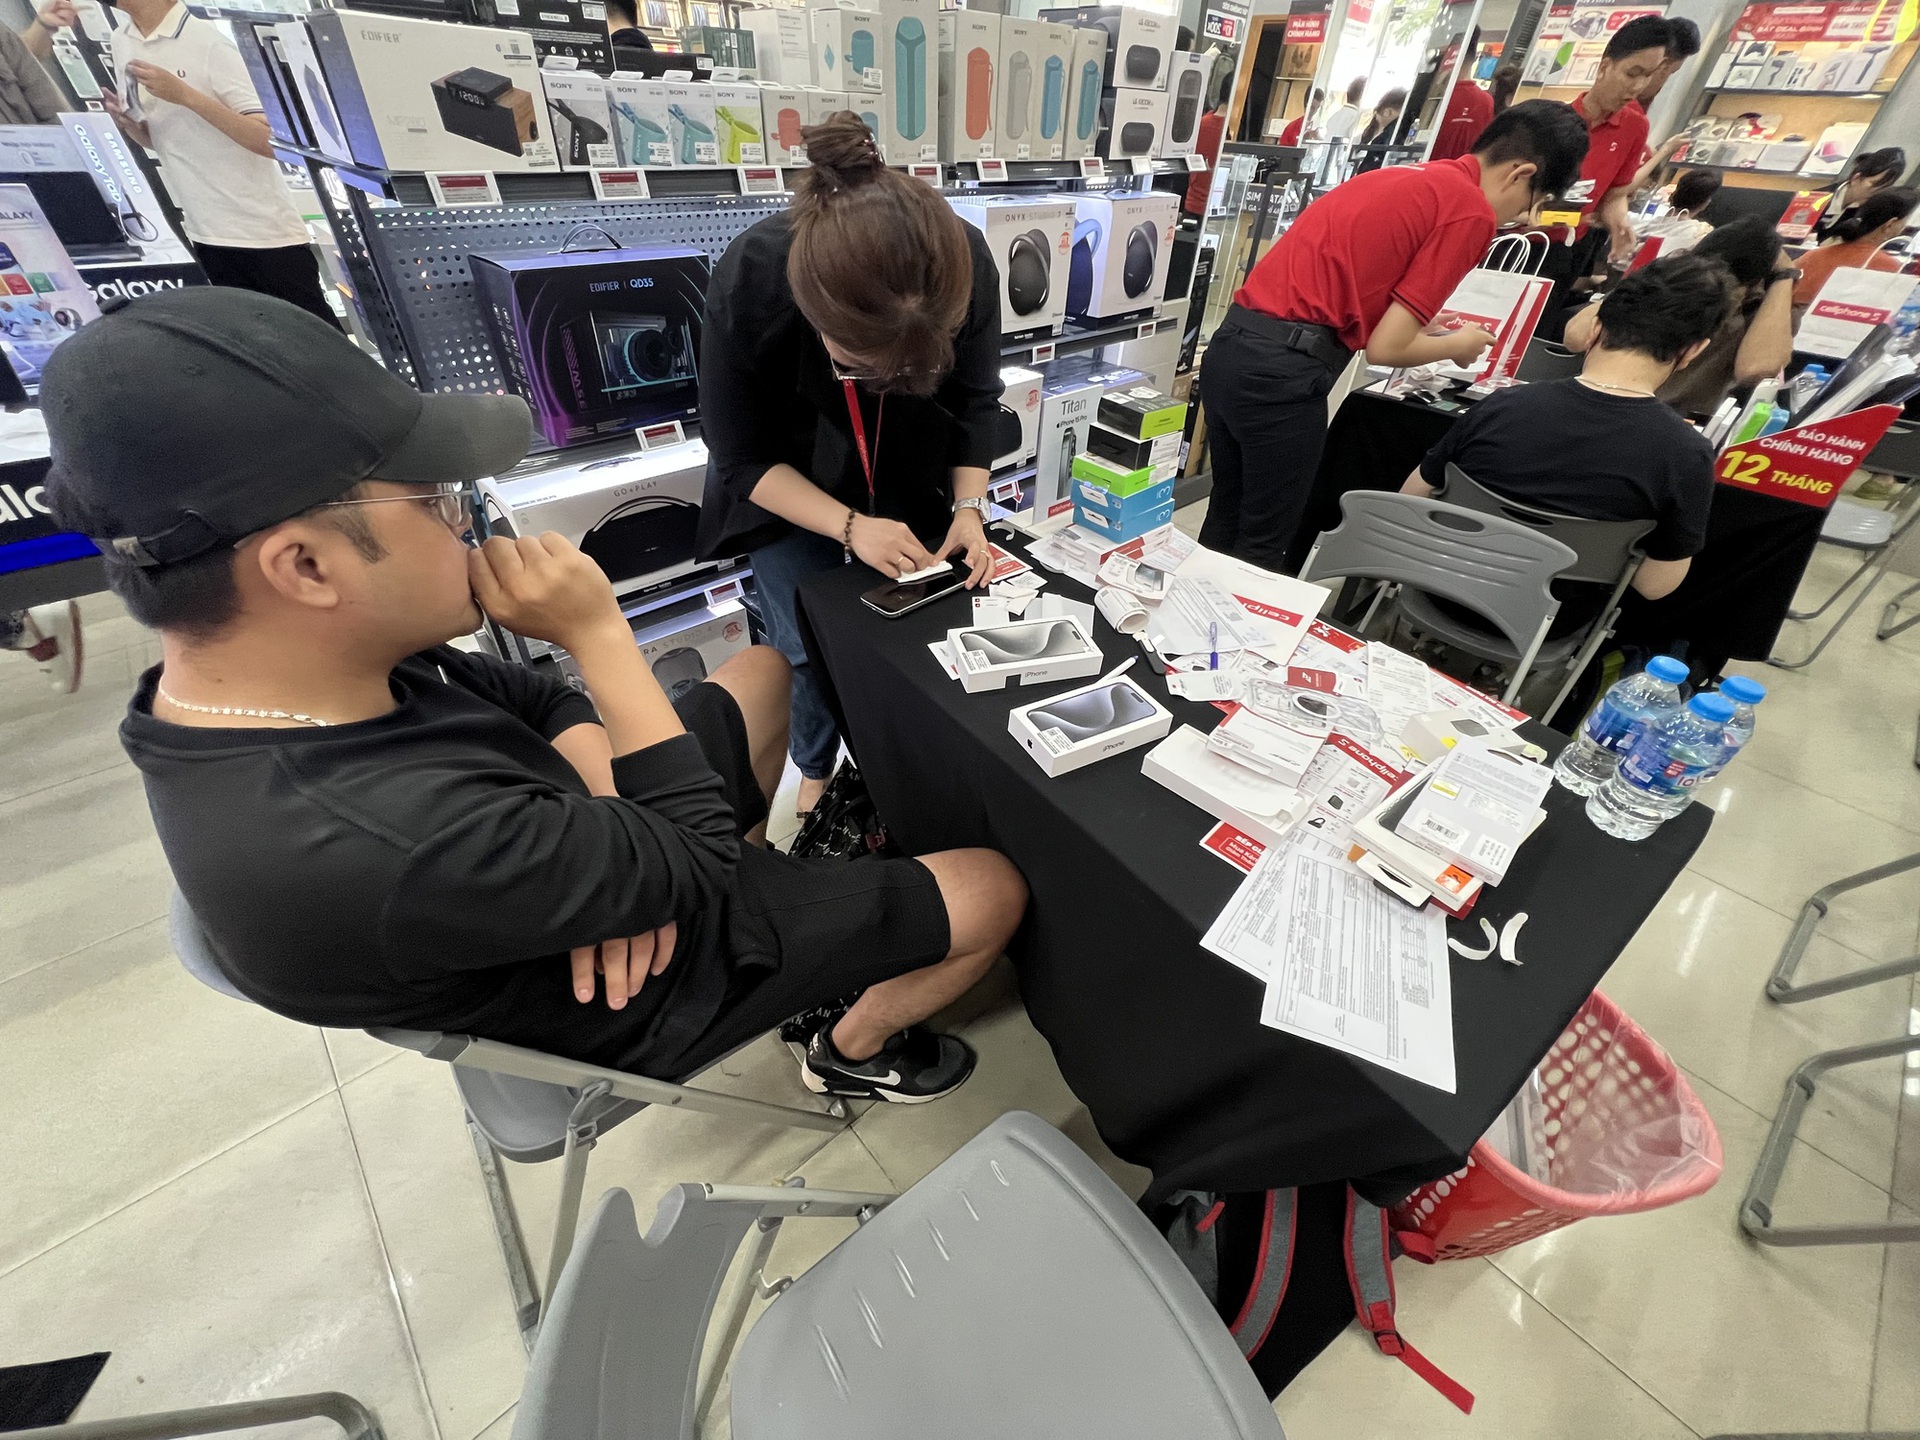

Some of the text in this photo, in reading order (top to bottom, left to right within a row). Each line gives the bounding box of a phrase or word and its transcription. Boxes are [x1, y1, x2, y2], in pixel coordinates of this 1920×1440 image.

[361, 30, 400, 44] EDIFIER
[74, 124, 122, 203] Galaxy Tab
[103, 131, 144, 194] SAMSUNG
[1246, 191, 1262, 202] SIM
[0, 210, 34, 220] ALAXY
[1005, 212, 1026, 222] ONYX
[1127, 206, 1142, 215] ONYX
[589, 278, 654, 293] EDIFIER QD35
[1820, 304, 1870, 318] cellphone
[1061, 398, 1086, 416] Titan
[1060, 418, 1075, 427] iPhone
[1760, 437, 1808, 456] CHÍNH
[1826, 434, 1866, 450] HÀNH
[1721, 450, 1834, 494] 12 THÁNG
[1024, 670, 1048, 678] iPhone
[1102, 740, 1125, 752] iPhone
